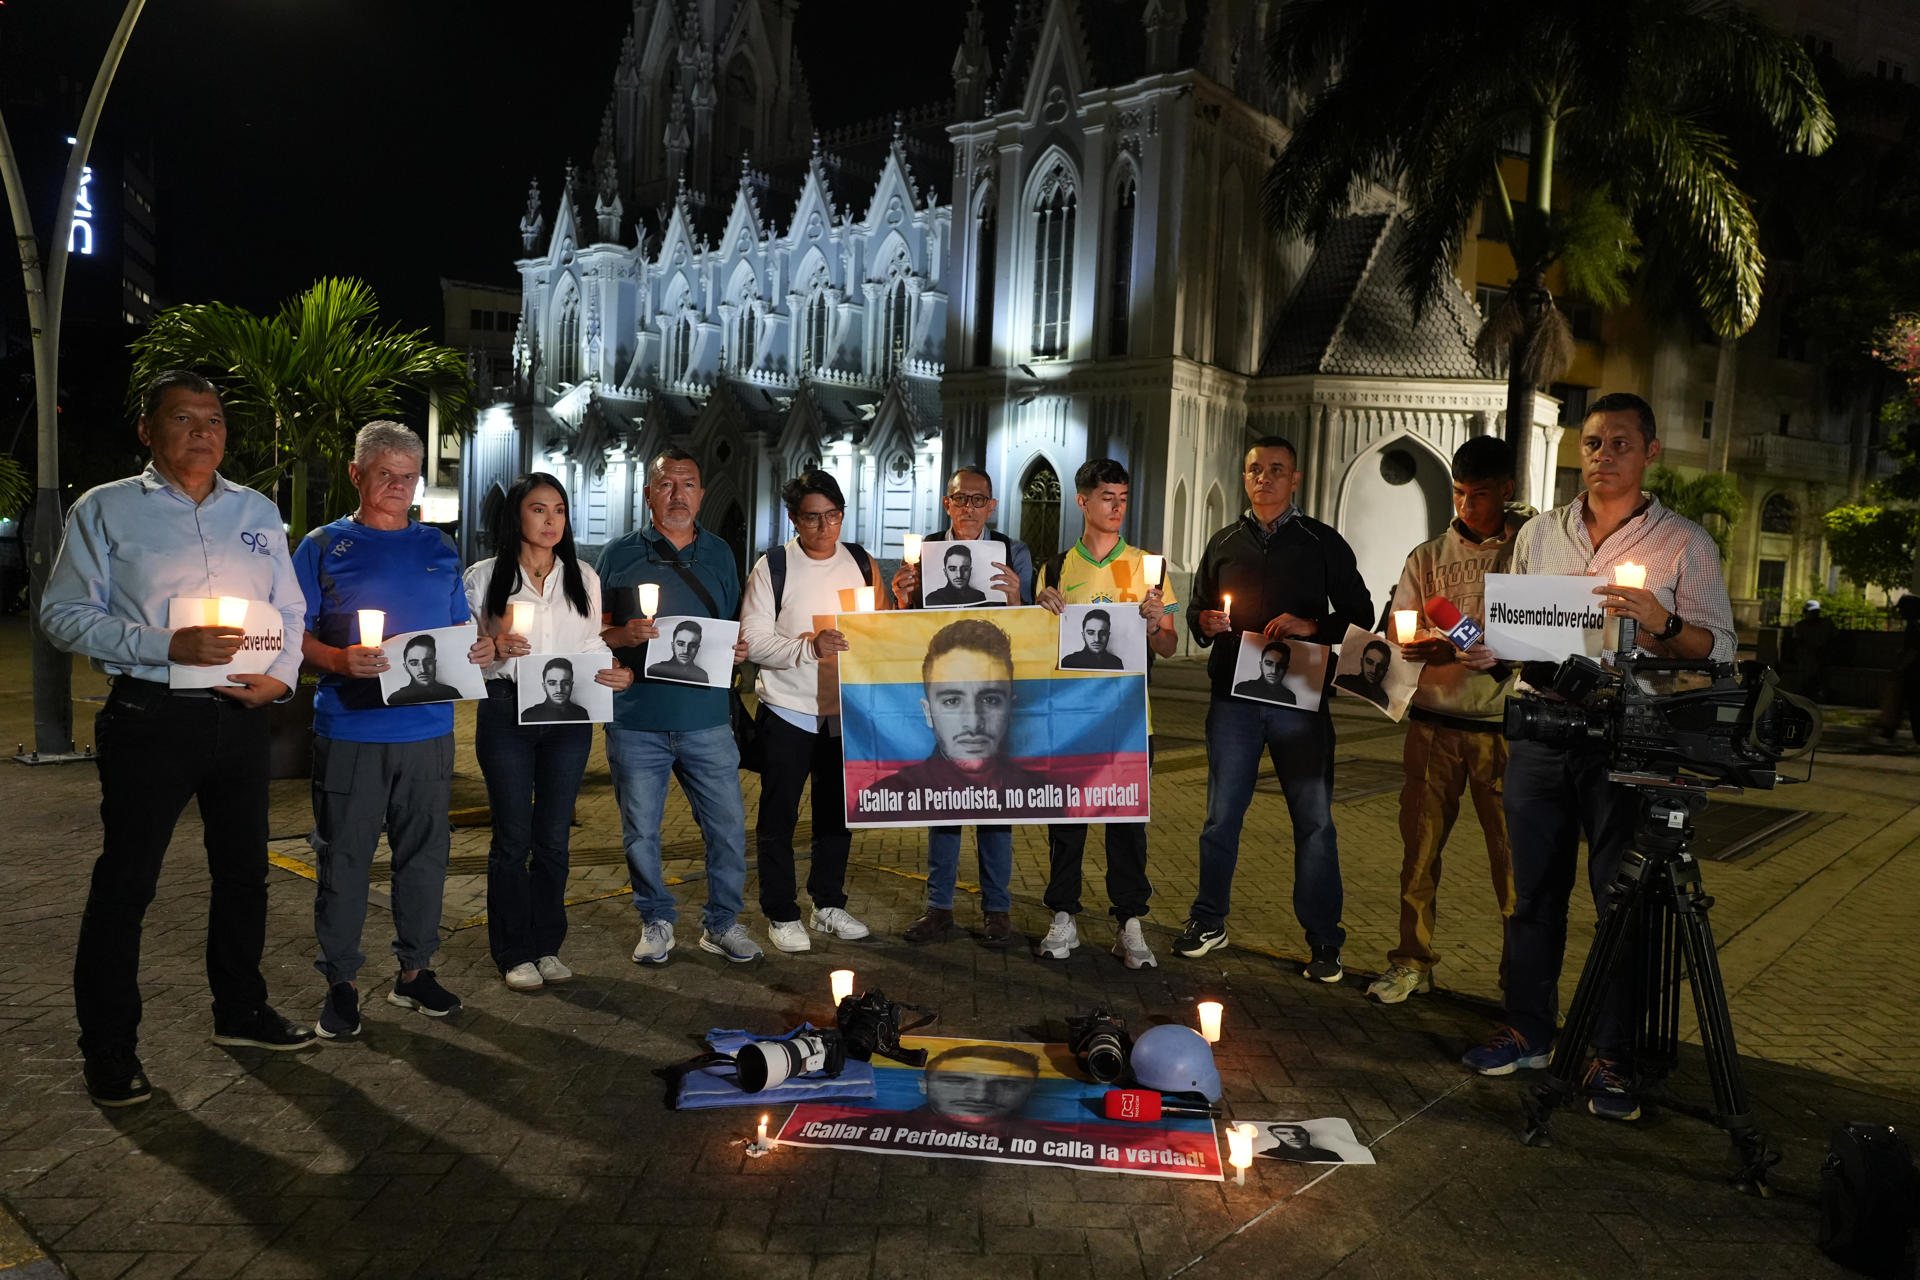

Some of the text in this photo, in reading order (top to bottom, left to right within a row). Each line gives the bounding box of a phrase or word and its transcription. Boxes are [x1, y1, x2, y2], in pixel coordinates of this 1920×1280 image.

[240, 532, 268, 552] 90
[1489, 602, 1605, 630] #Nosematalaverdad
[858, 782, 1139, 812] !Callar al Periodista, no calla la verdad!
[800, 1121, 1206, 1168] !Callar al Periodista, no calla la verdad!
